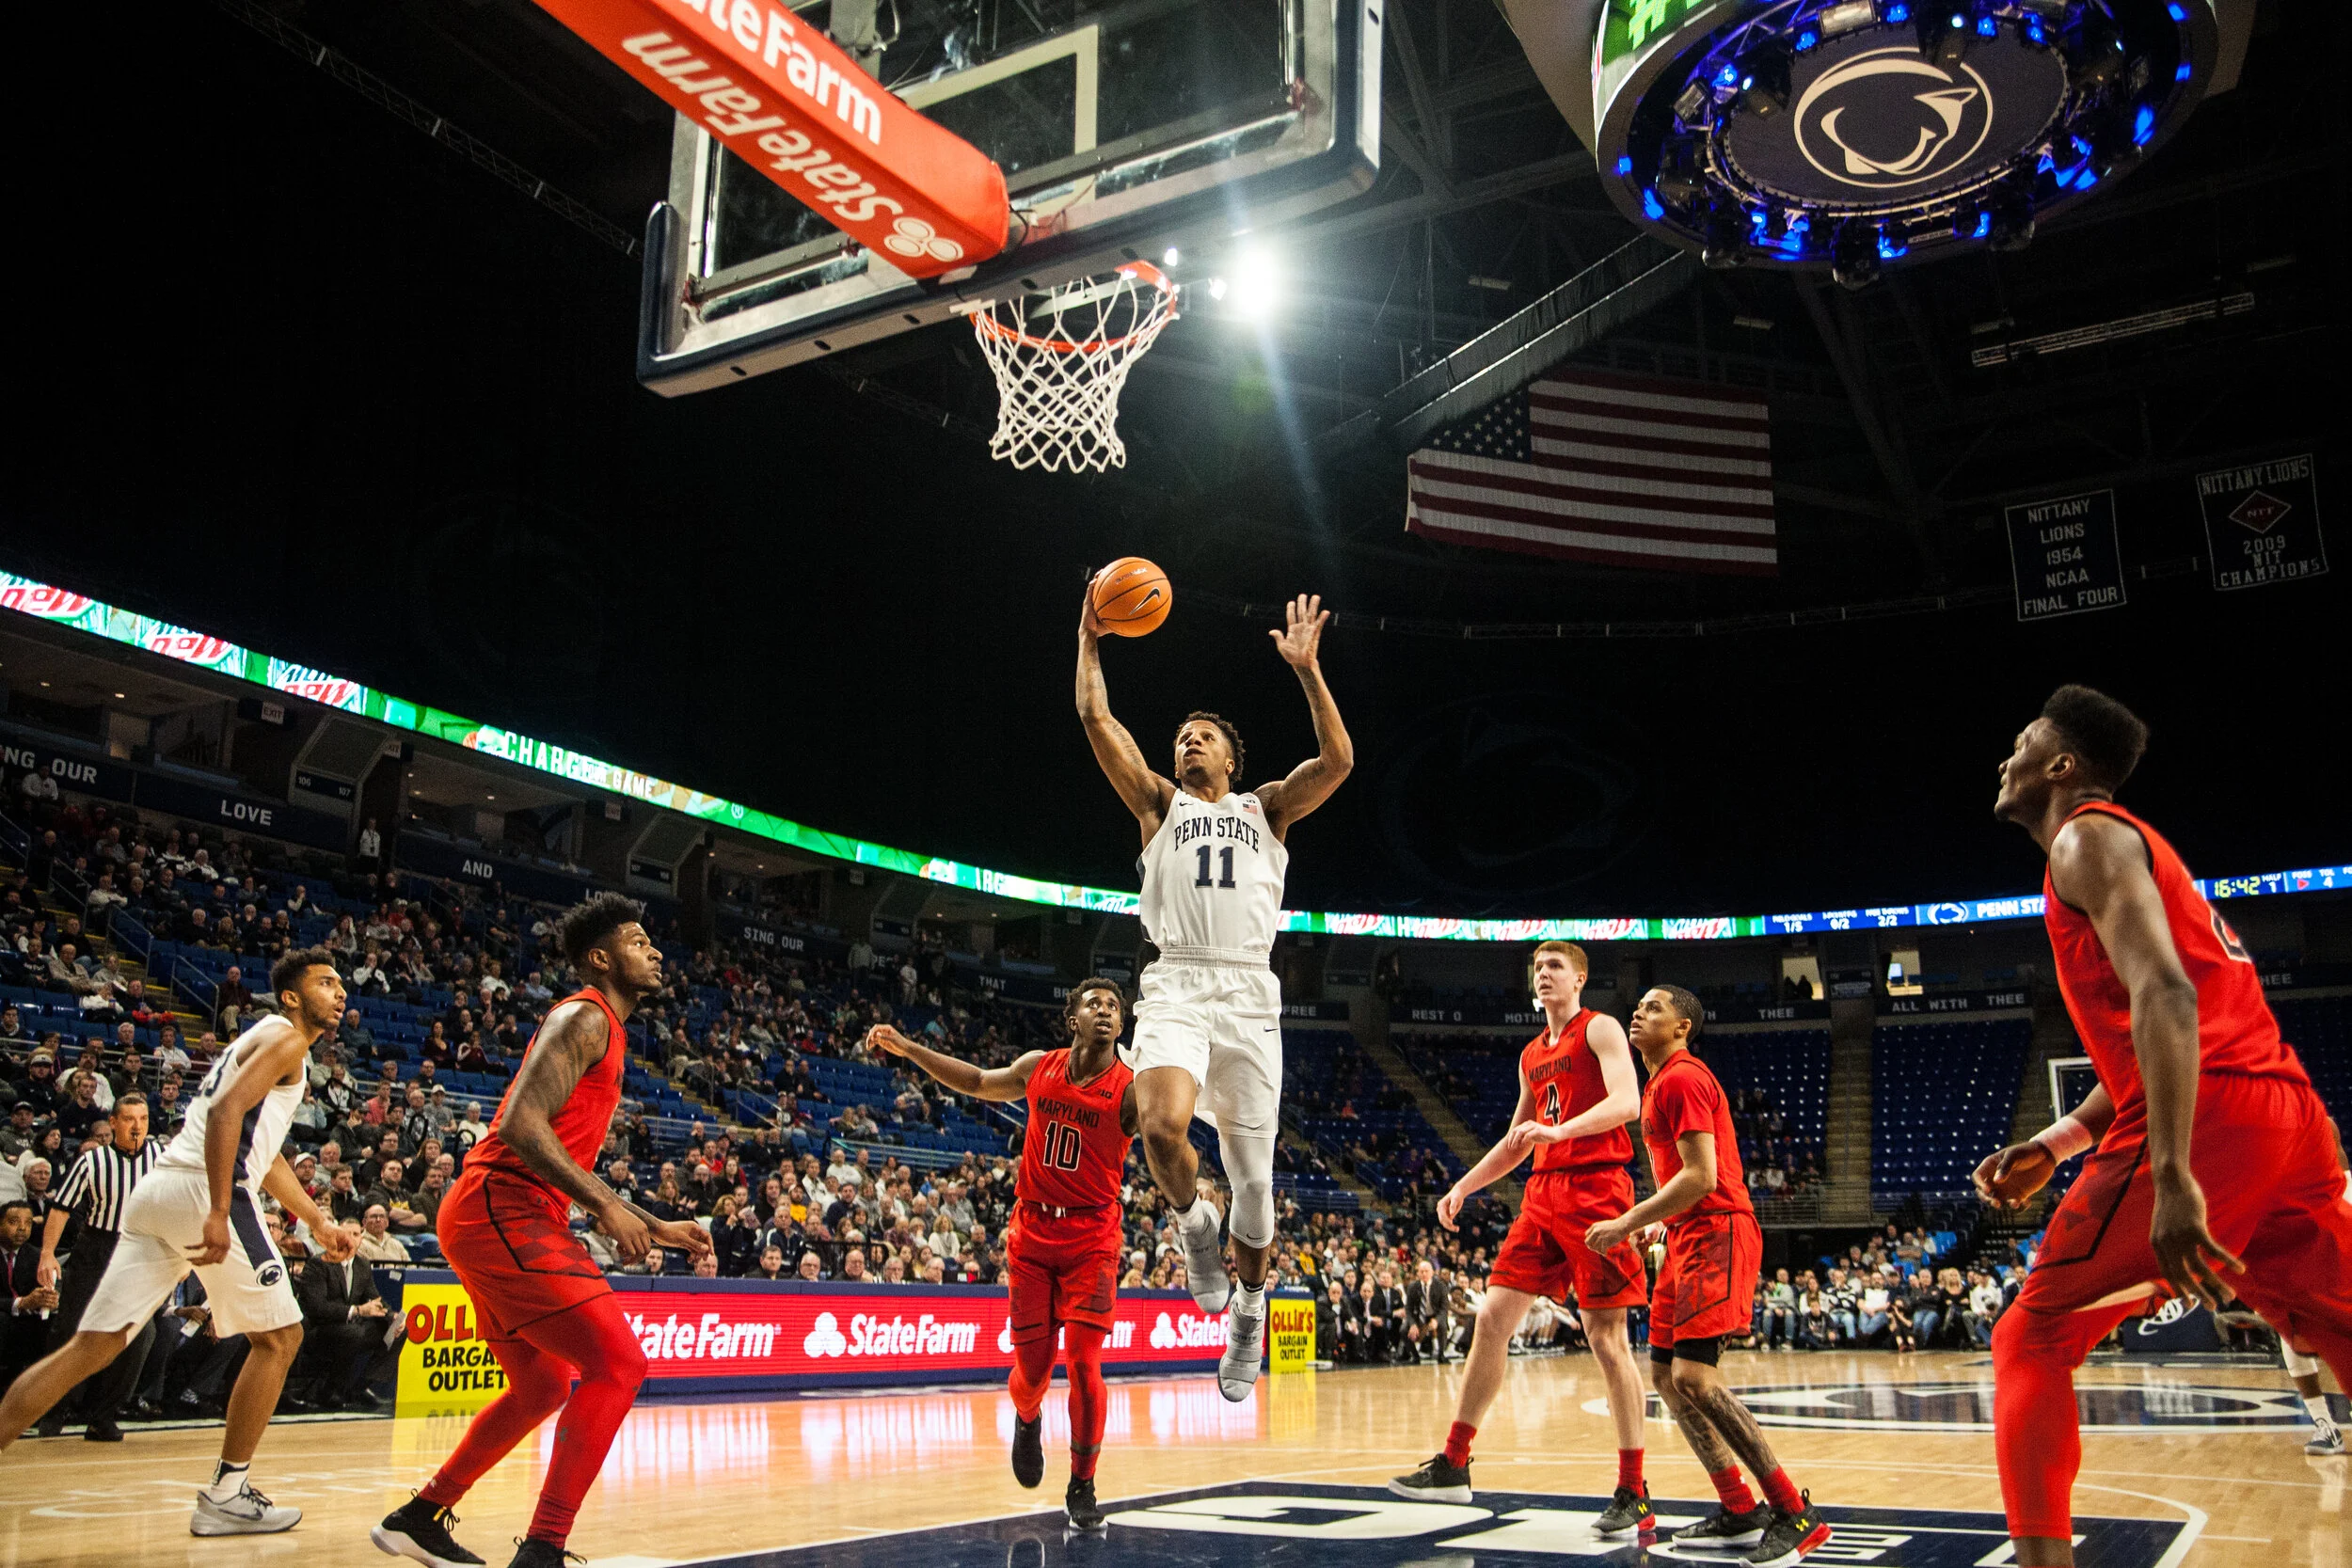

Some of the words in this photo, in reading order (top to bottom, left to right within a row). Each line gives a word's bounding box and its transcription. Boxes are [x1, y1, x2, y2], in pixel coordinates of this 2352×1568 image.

[681, 0, 882, 146] teFarm
[622, 31, 903, 222] StateFarm
[2201, 466, 2264, 497] NITTANY
[2266, 458, 2310, 485] LIONS
[2026, 498, 2091, 524] NITTANY
[2040, 522, 2085, 544] LIONS
[2243, 534, 2286, 556] 2009
[2046, 546, 2084, 566] 1954
[2251, 549, 2281, 568] NIT
[2044, 567, 2090, 590] NCAA
[2220, 557, 2321, 587] CHAMPIONS
[2024, 594, 2070, 615] FINAL
[2076, 586, 2118, 607] FOUR
[3, 746, 36, 769] NG
[52, 757, 98, 784] OUR
[612, 769, 653, 799] GAME
[220, 799, 273, 827] LOVE
[1174, 816, 1213, 852] PENN
[1217, 816, 1259, 854] STATE
[462, 859, 493, 879] AND
[1195, 845, 1235, 890] 11
[2214, 876, 2261, 899] 16:42
[2269, 881, 2277, 893] 1
[2323, 876, 2333, 888] 4
[1977, 901, 2019, 918] PENN
[2020, 897, 2046, 914] STA
[1878, 915, 1898, 927] 2/2
[744, 927, 775, 945] SING
[781, 935, 804, 953] OUR
[978, 974, 1007, 992] THAT
[2260, 973, 2293, 986] HEE
[1758, 1006, 1795, 1021] THEE
[1892, 1000, 1919, 1013] ALL
[1929, 997, 1968, 1010] WITH
[1987, 992, 2026, 1006] THEE
[1412, 1009, 1445, 1022] REST
[1529, 1054, 1573, 1082] MARYLAND
[1036, 1094, 1100, 1129] MARYLAND
[1544, 1082, 1562, 1127] 4
[1042, 1120, 1082, 1171] 10
[1177, 1313, 1231, 1347] StateF
[1272, 1307, 1313, 1334] OLLIE'S
[623, 1312, 775, 1359] tateFarm
[848, 1313, 977, 1356] StateFarm
[1278, 1334, 1308, 1347] BARGAIN
[422, 1347, 498, 1368] BARGA
[1280, 1349, 1305, 1360] OUTLET
[428, 1370, 504, 1392] OUTLET
